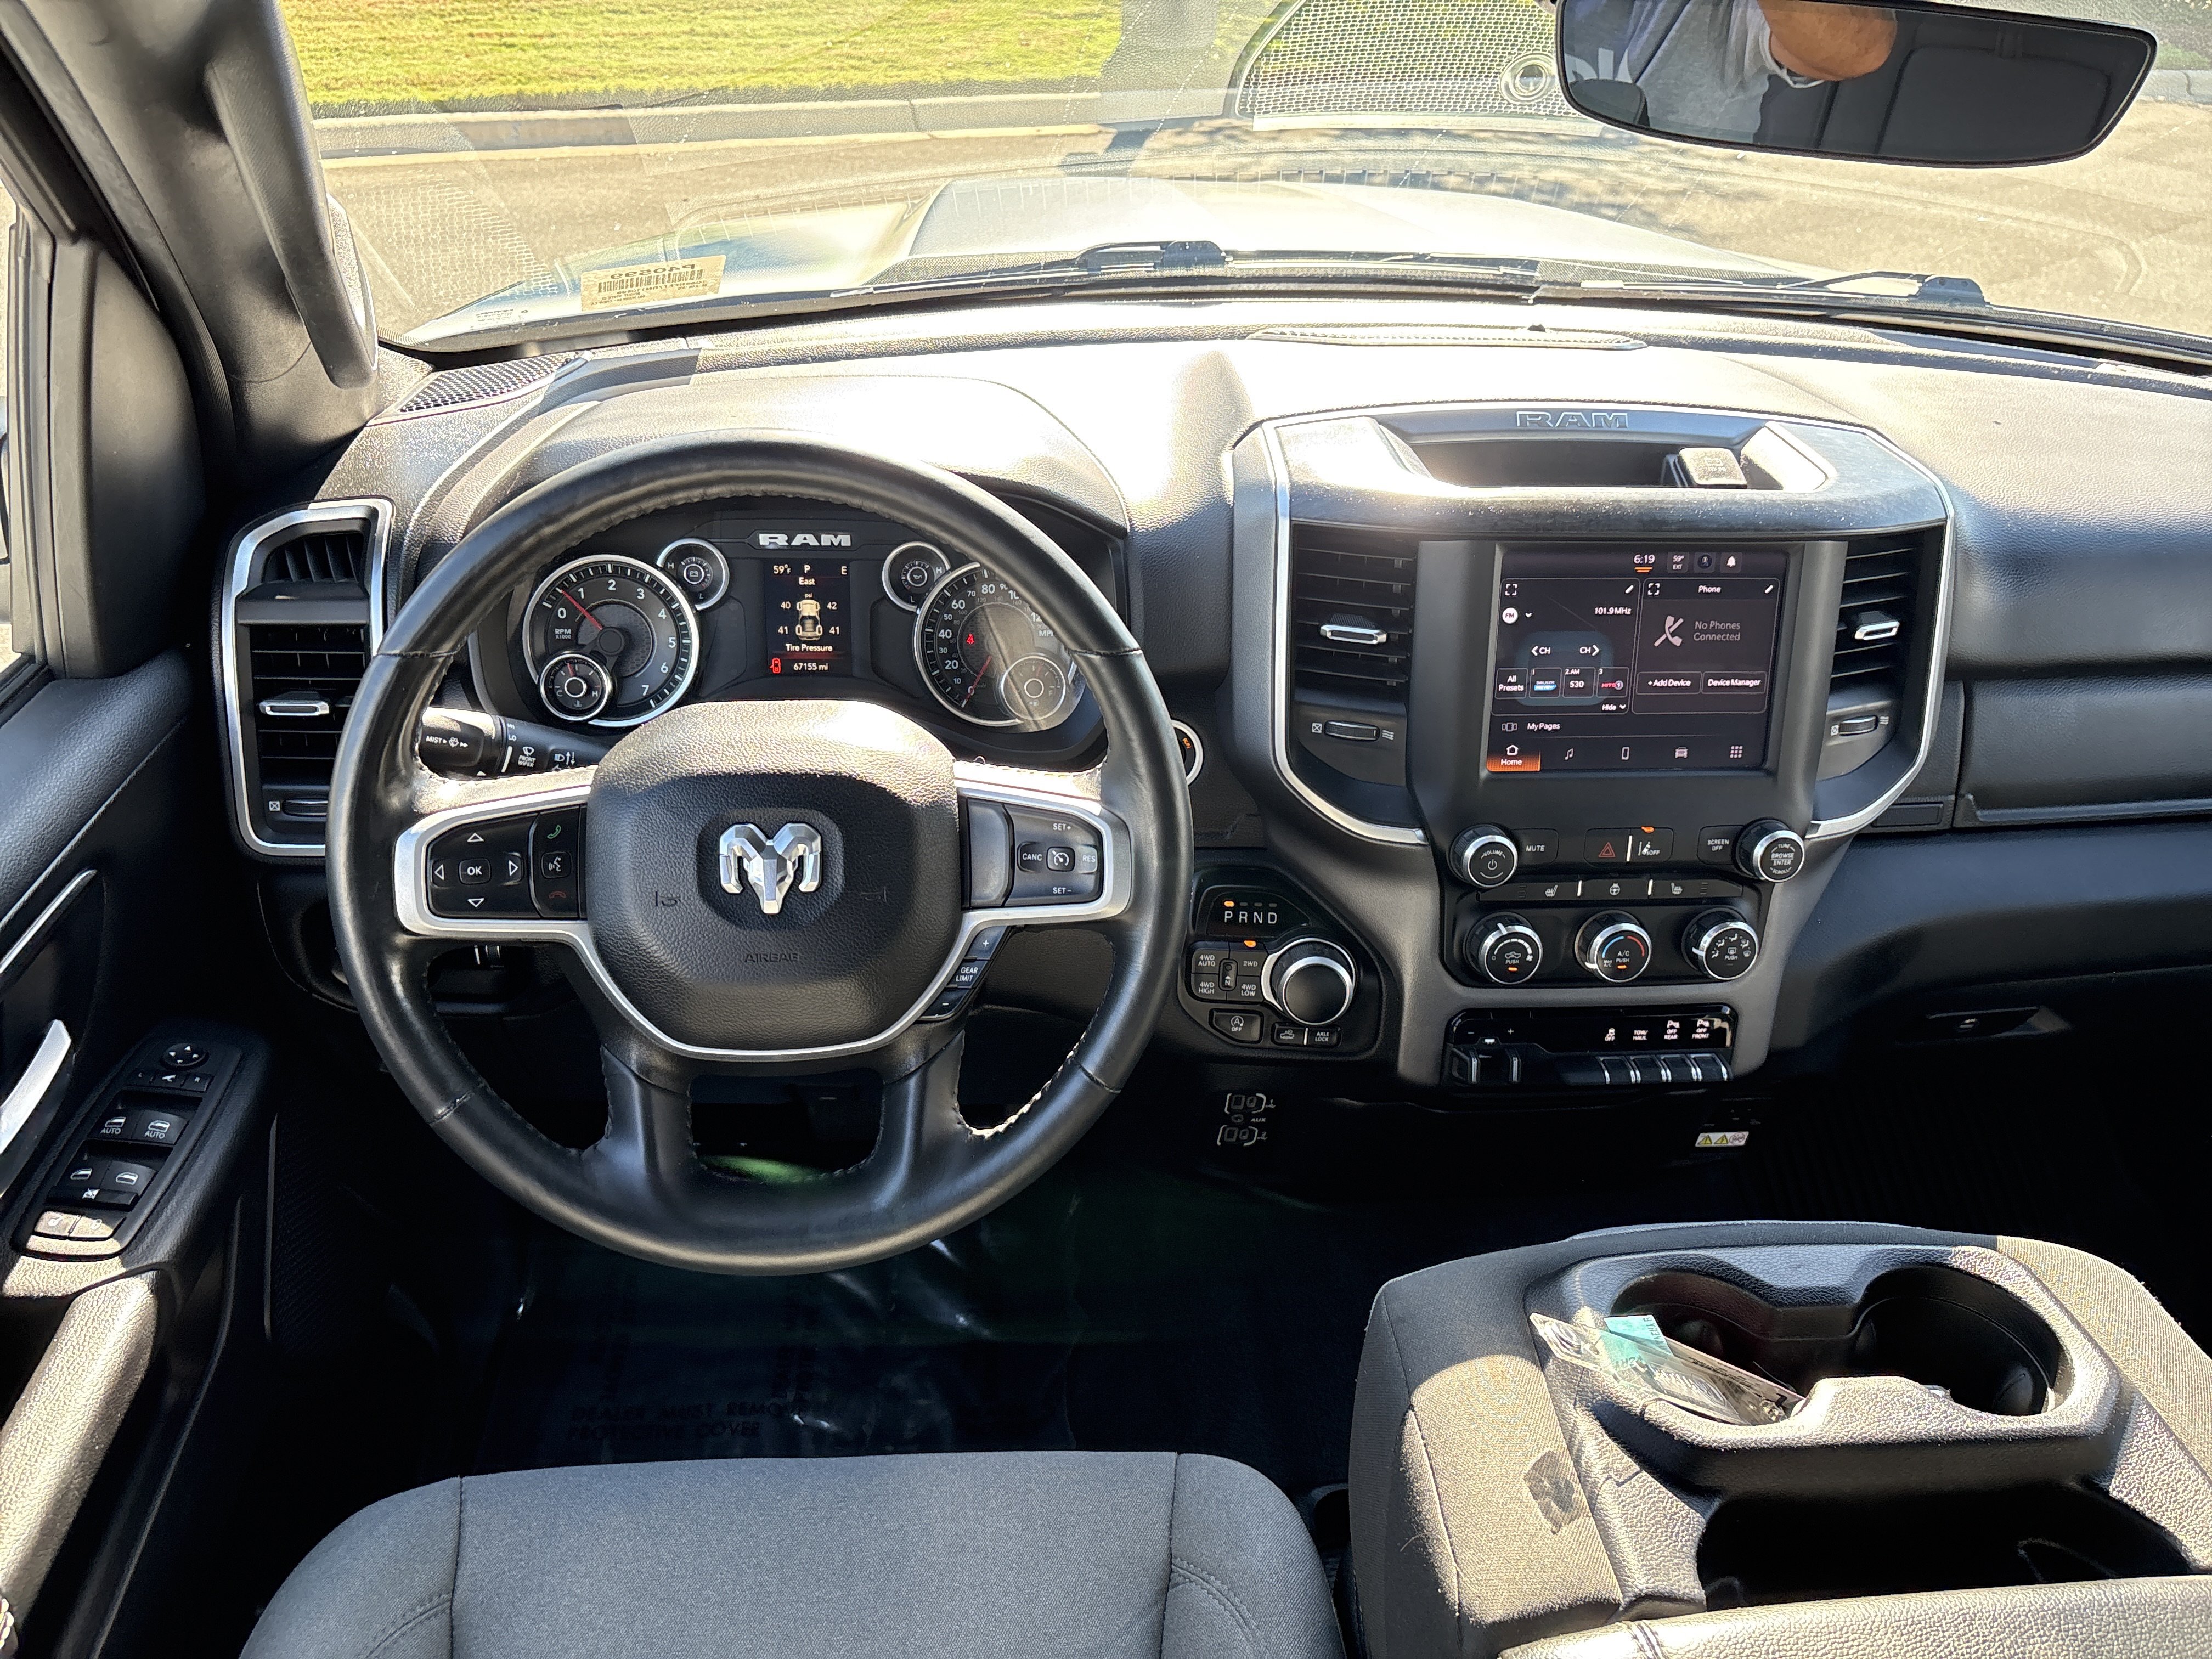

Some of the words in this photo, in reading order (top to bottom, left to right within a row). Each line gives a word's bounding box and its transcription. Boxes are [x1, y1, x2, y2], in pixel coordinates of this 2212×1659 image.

[1516, 411, 1629, 429] RAM
[759, 533, 851, 547] RAM
[1634, 554, 1655, 564] 6:19
[804, 565, 811, 574] P
[841, 566, 848, 575] E
[608, 579, 616, 590] 2
[981, 584, 995, 594] 80
[578, 588, 584, 599] 1
[636, 588, 645, 599] 3
[951, 600, 966, 609] 60
[558, 608, 566, 619] 0
[658, 608, 667, 619] 4
[1031, 612, 1042, 622] 12
[777, 626, 788, 634] 41
[829, 626, 840, 635] 41
[1695, 621, 1708, 630] No
[1709, 621, 1741, 630] Phones
[938, 630, 952, 639] 40
[1694, 633, 1740, 641] Connected
[669, 637, 676, 648] 5
[661, 662, 668, 673] 6
[945, 660, 958, 669] 20
[1731, 679, 1762, 687] Manager
[641, 685, 649, 696] 7
[426, 735, 442, 744] MIST
[1182, 737, 1192, 749] RUN
[1483, 849, 1504, 857] VOLUME
[467, 866, 483, 876] OK
[144, 1131, 165, 1139] AUTO
